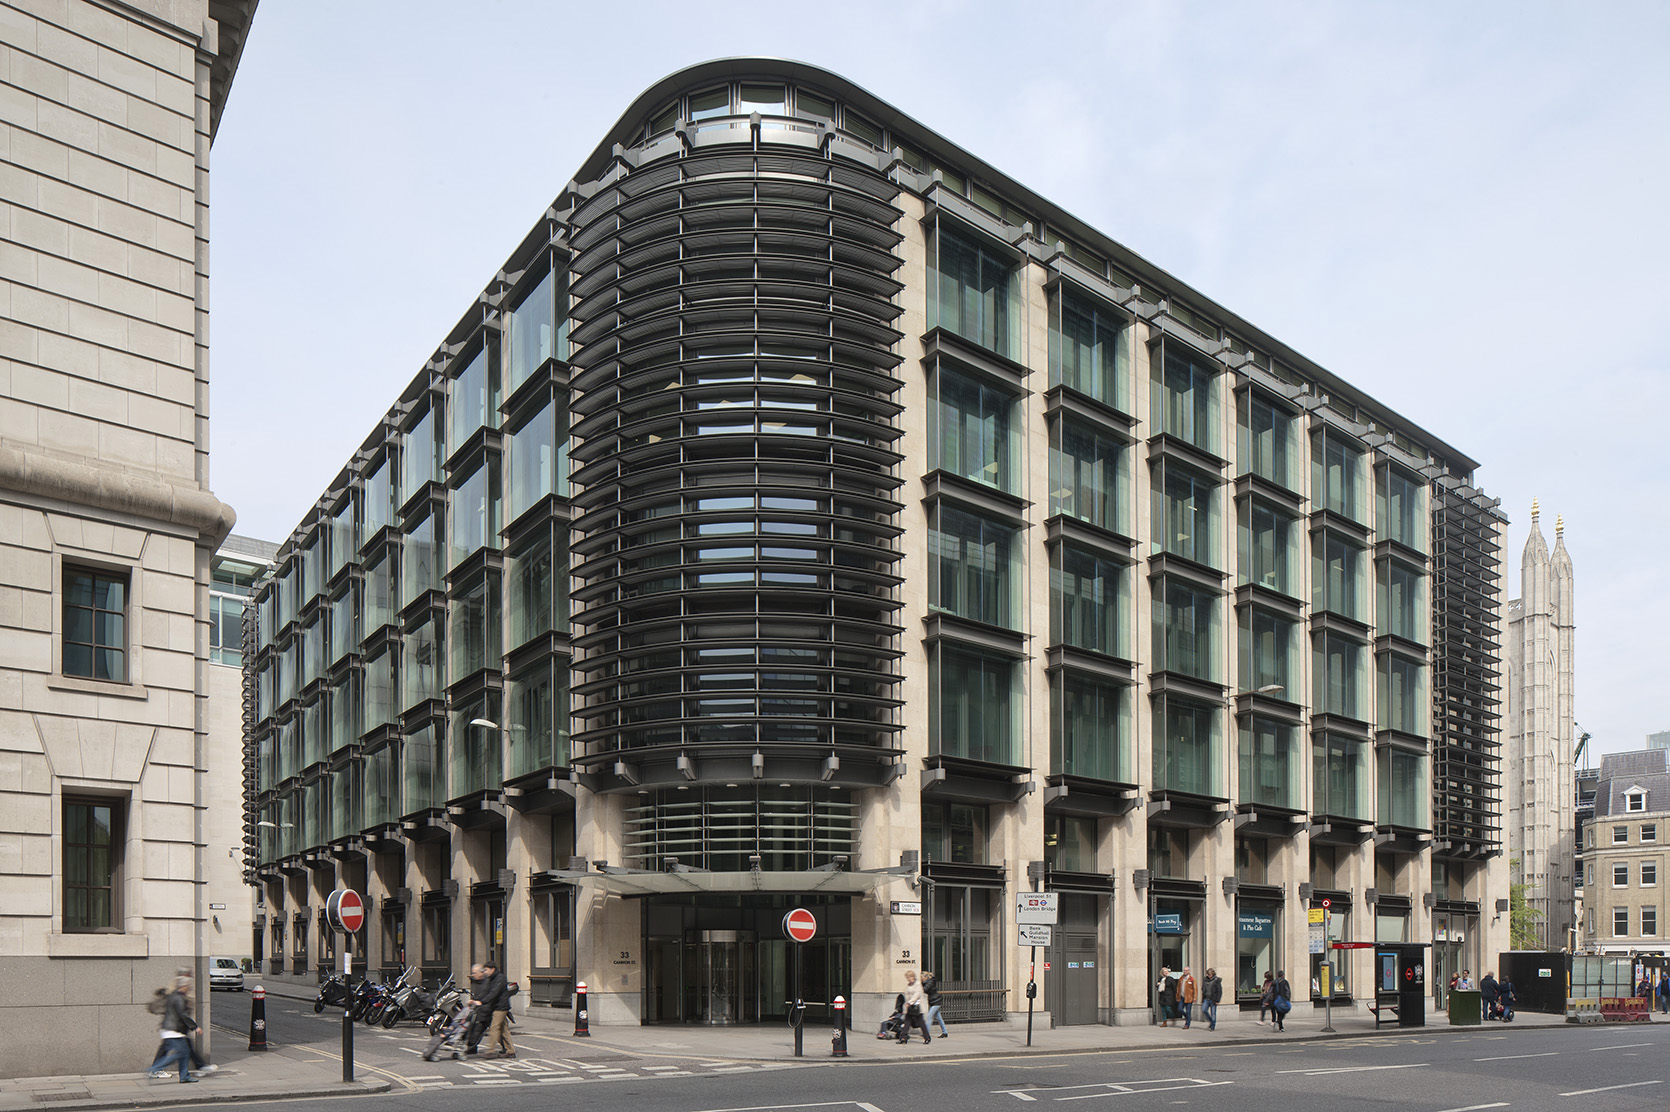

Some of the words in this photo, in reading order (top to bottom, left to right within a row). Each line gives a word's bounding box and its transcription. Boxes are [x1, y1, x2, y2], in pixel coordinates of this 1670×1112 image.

[620, 951, 630, 959] 33
[902, 950, 910, 958] 33
[456, 1058, 608, 1073] TURN
